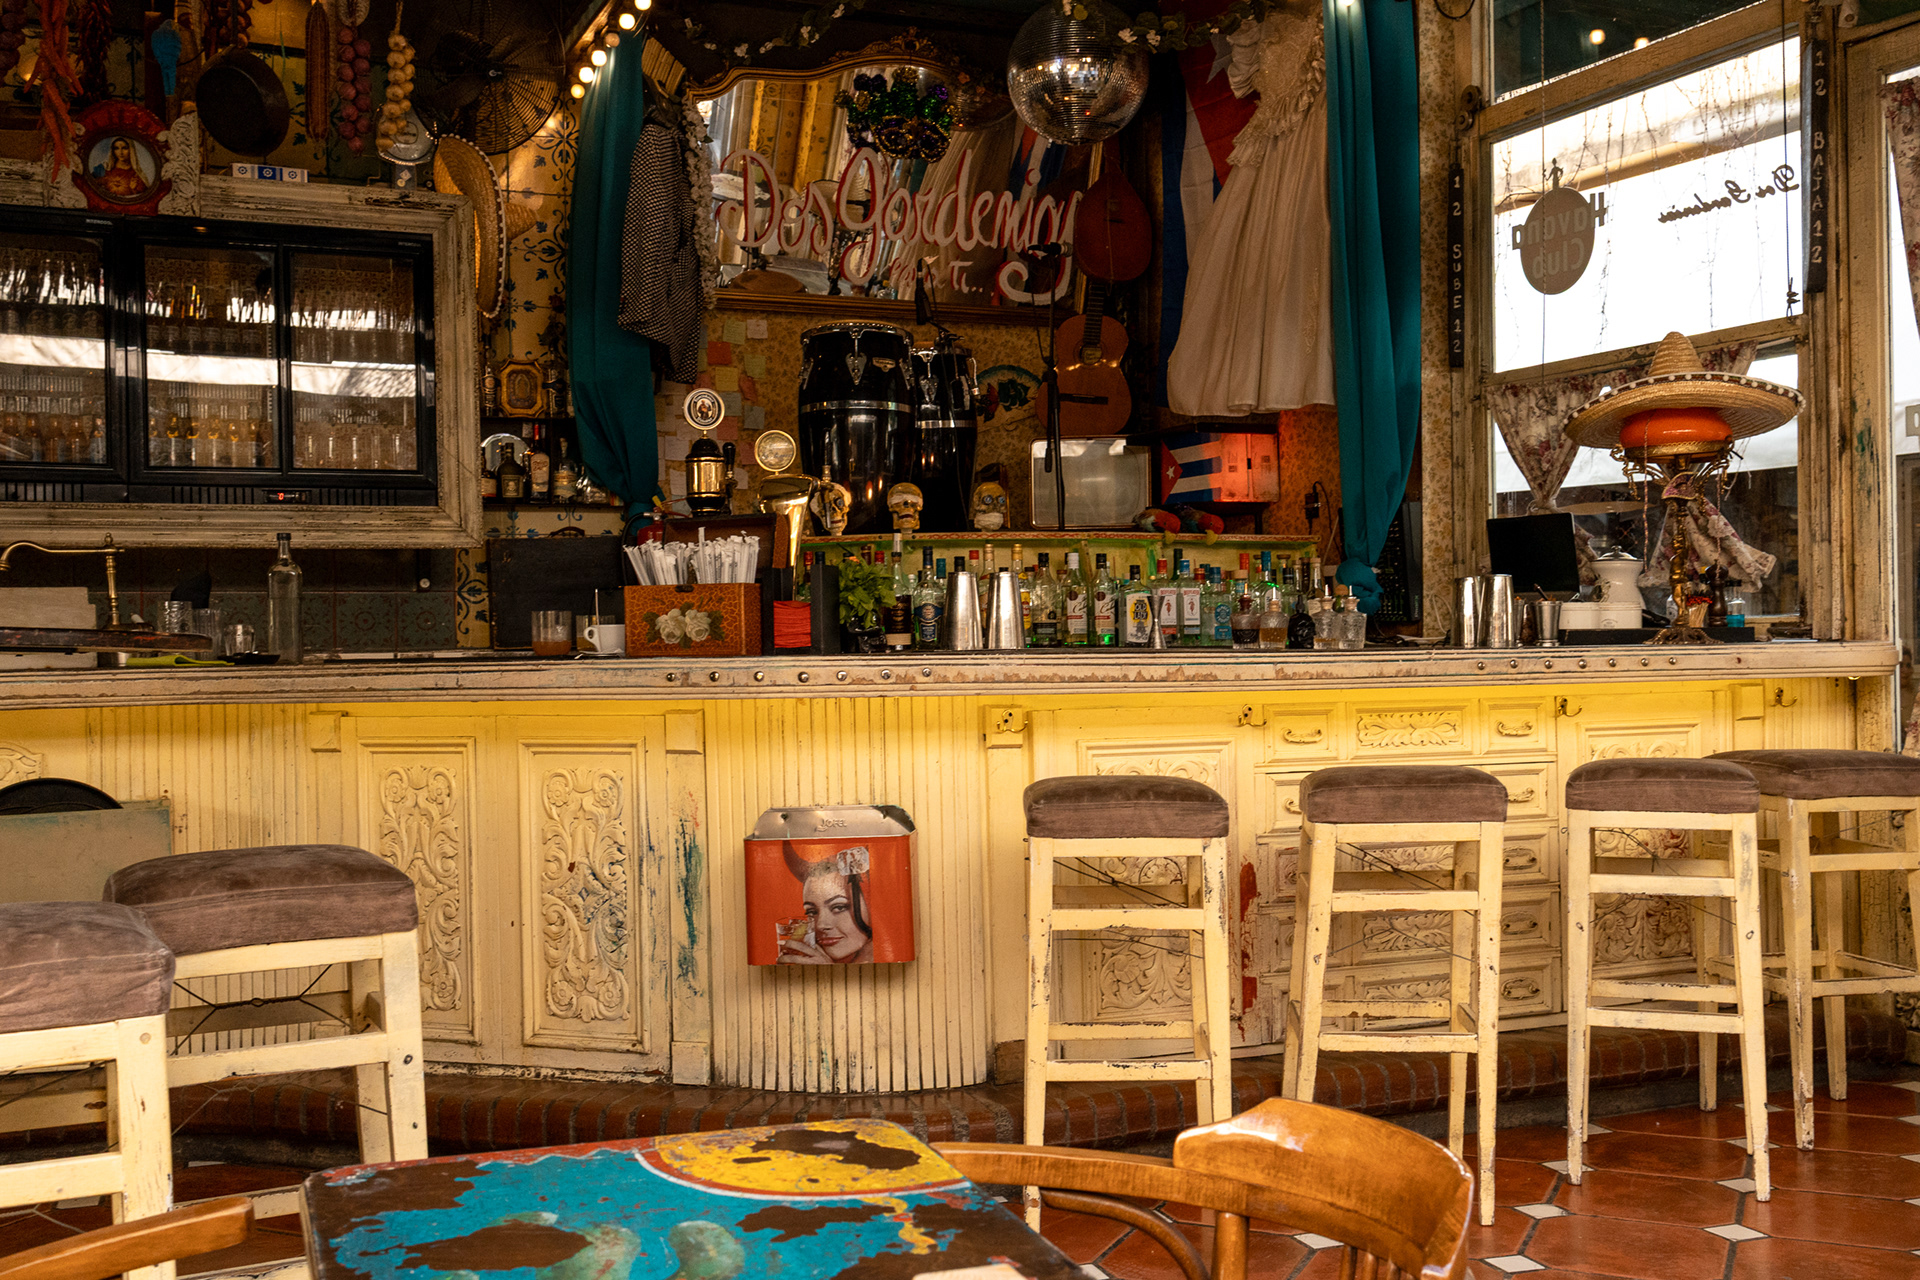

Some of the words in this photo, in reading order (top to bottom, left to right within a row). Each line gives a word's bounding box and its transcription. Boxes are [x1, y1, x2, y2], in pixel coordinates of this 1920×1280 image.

[715, 149, 834, 257] Dos
[1811, 131, 1825, 211] BAJA
[1452, 243, 1463, 310] SUBE
[814, 818, 848, 832] JOFEL
